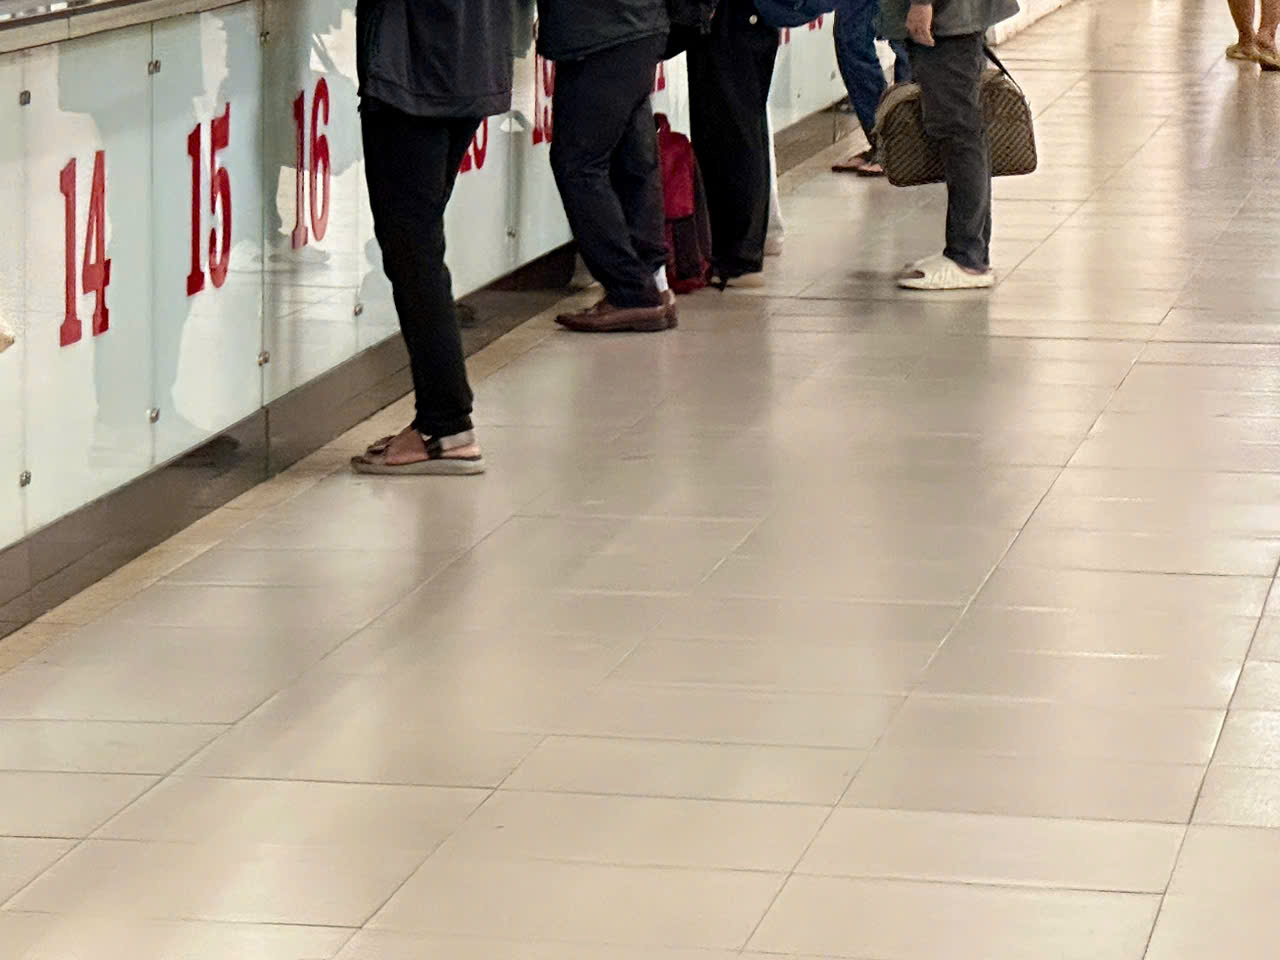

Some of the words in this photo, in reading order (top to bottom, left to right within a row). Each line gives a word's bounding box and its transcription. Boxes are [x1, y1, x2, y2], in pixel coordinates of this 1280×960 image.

[60, 150, 111, 348] 14
[186, 102, 232, 297] 15
[291, 76, 331, 250] 16
